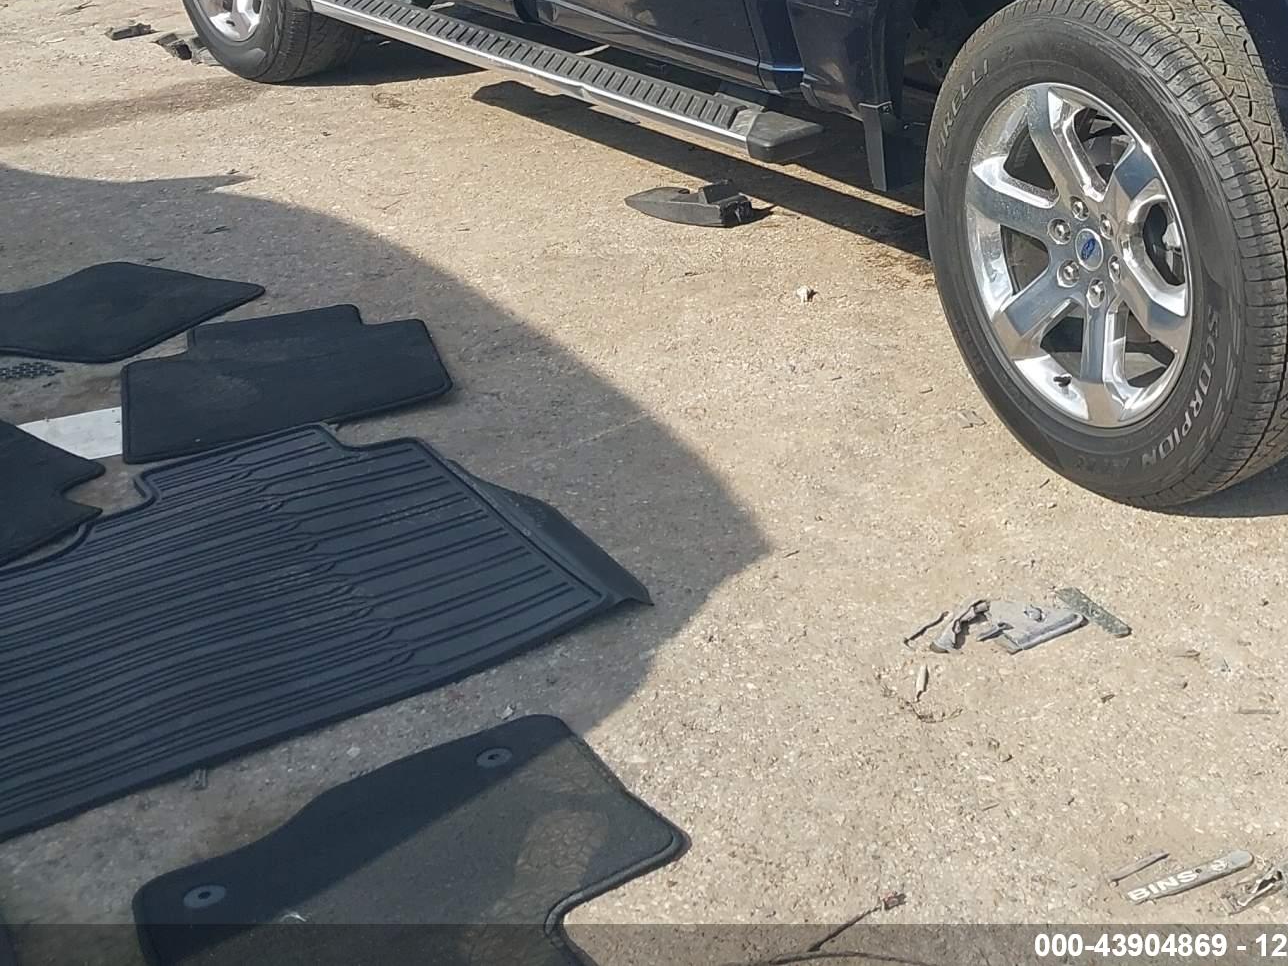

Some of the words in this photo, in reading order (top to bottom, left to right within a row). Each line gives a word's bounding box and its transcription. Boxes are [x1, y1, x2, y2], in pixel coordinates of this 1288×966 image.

[935, 57, 991, 171] PIRELLI
[1141, 306, 1220, 468] SCORPION
[1127, 870, 1198, 901] BINS
